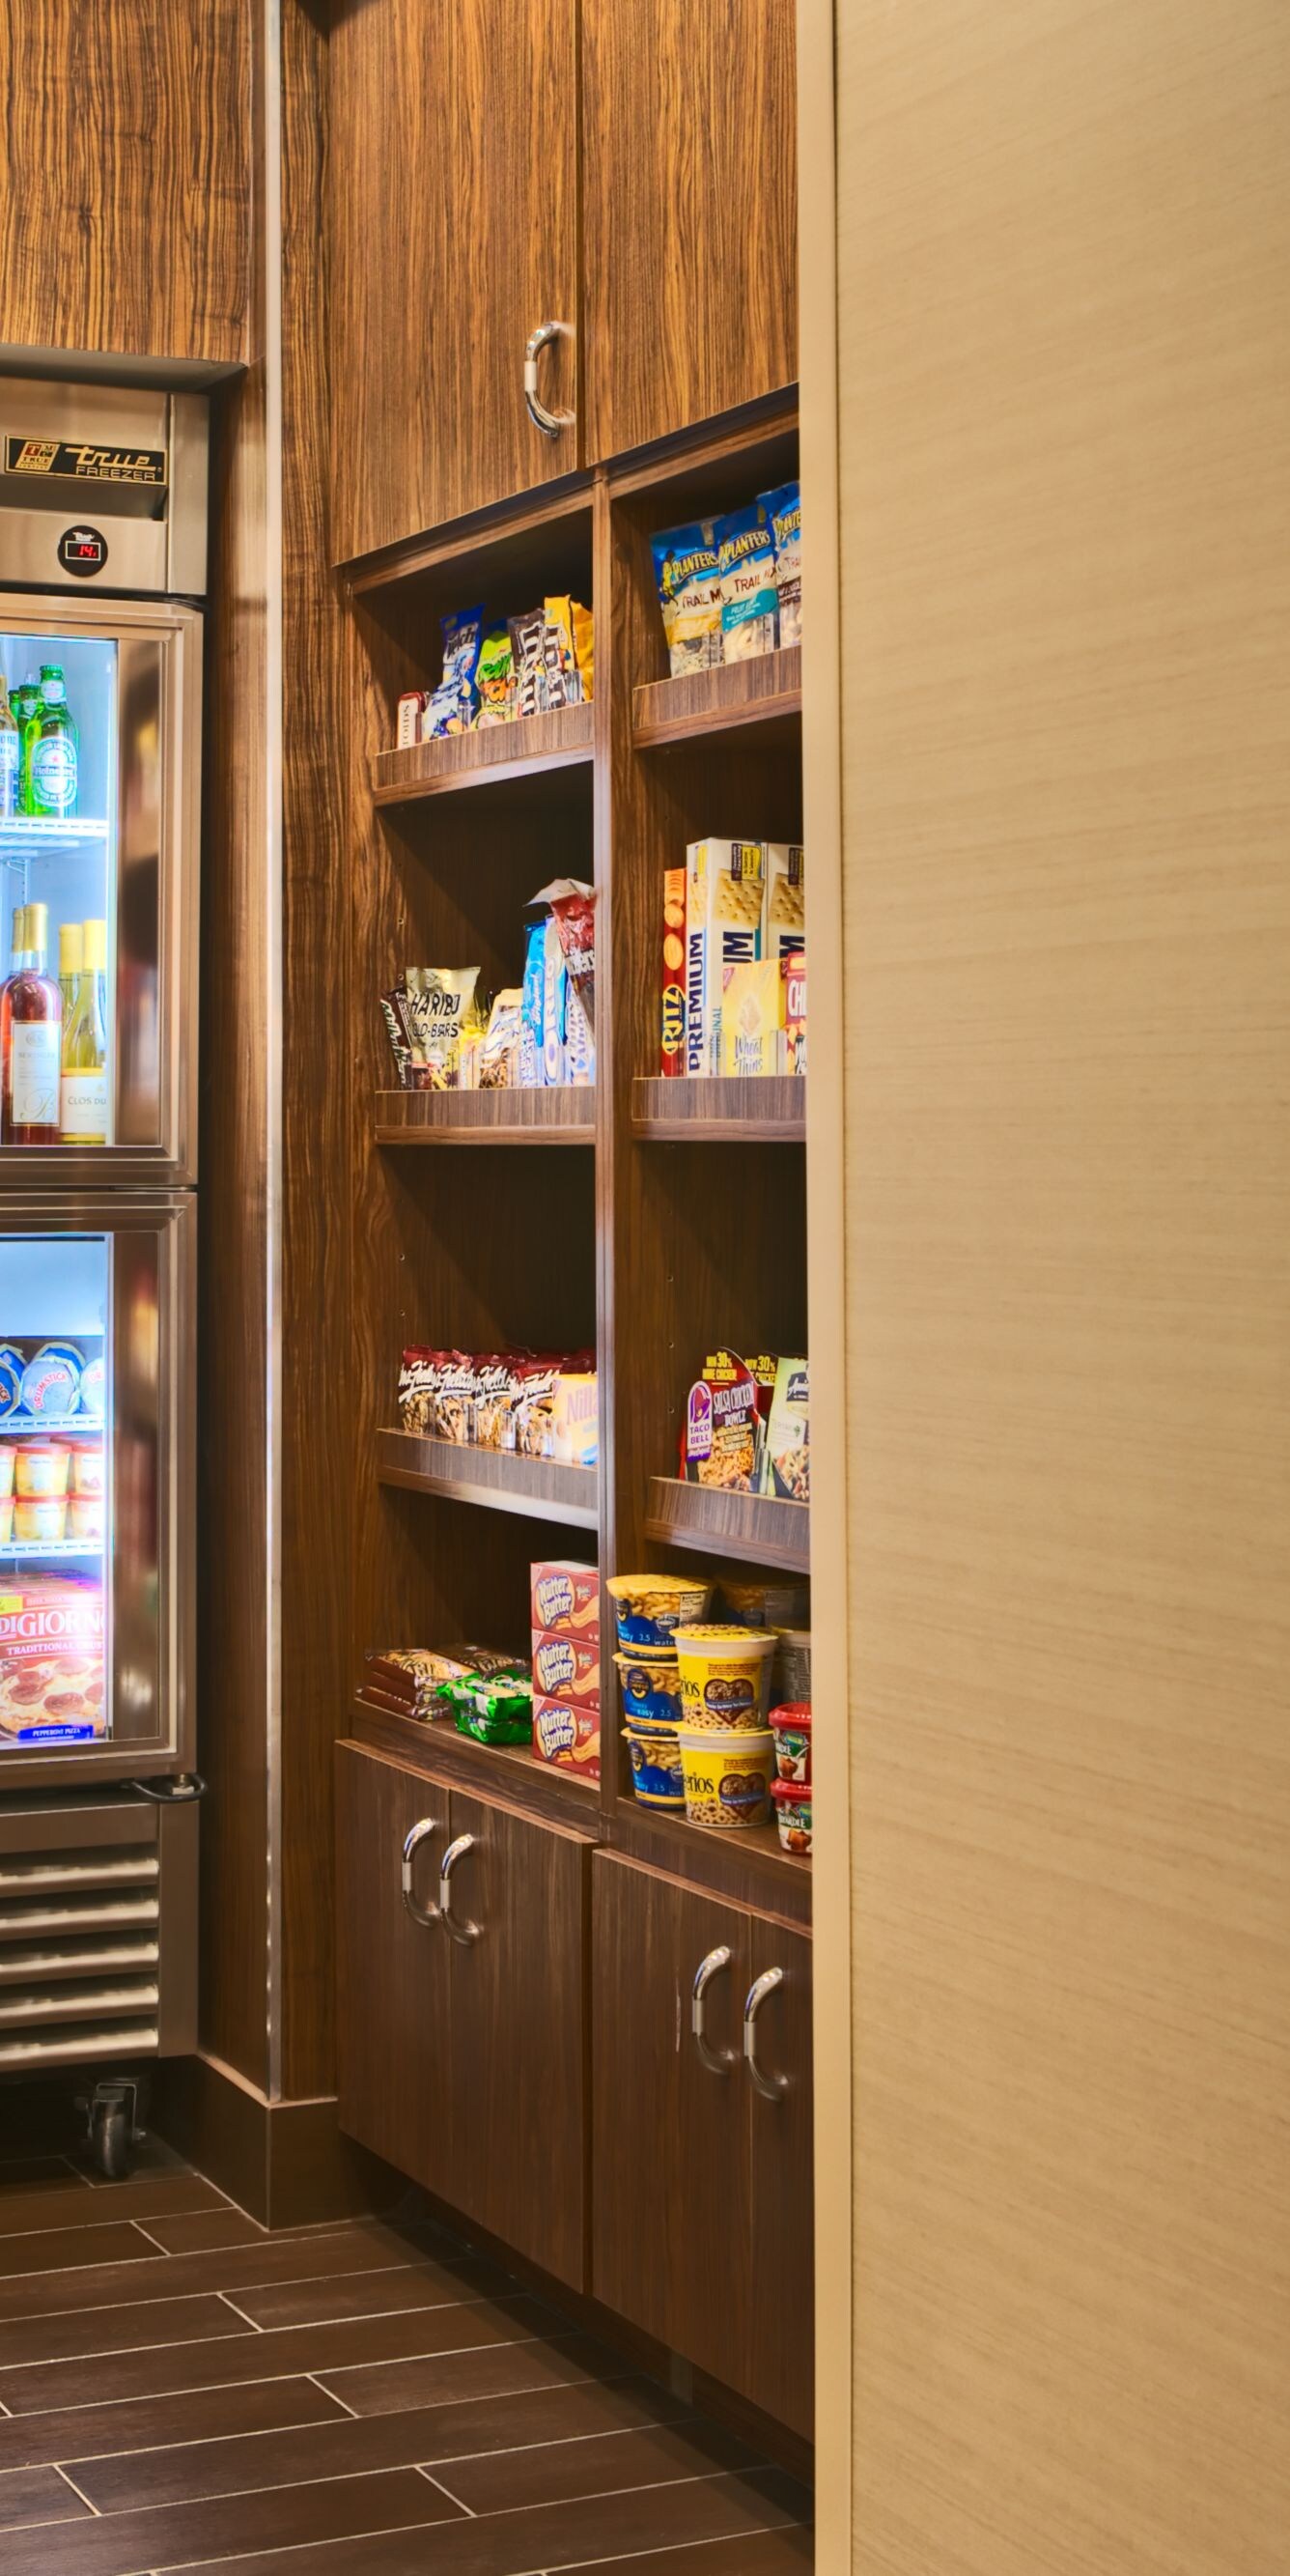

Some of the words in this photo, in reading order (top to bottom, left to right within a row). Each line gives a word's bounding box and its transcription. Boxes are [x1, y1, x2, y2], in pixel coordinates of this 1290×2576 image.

[75, 466, 155, 481] FREEZER
[722, 530, 771, 564] PLANTERS
[735, 575, 761, 593] TRAIL
[682, 591, 709, 609] TRAIL
[688, 932, 704, 1071] PREMIUM
[662, 989, 684, 1050] RITZ
[734, 1034, 764, 1060] Wheat
[733, 1057, 764, 1078] Thins
[68, 1095, 92, 1105] CLOS
[34, 1372, 67, 1409] DRUMSTICK
[689, 1424, 711, 1434] TACO
[689, 1435, 710, 1445] BELL
[537, 1574, 569, 1604] Nutter
[543, 1594, 573, 1628] Butter
[8, 1643, 73, 1656] TRADITIONAL
[539, 1641, 570, 1670] Nutter
[543, 1660, 574, 1694] Butter
[539, 1707, 571, 1737] Nutter
[543, 1726, 574, 1759] Butter
